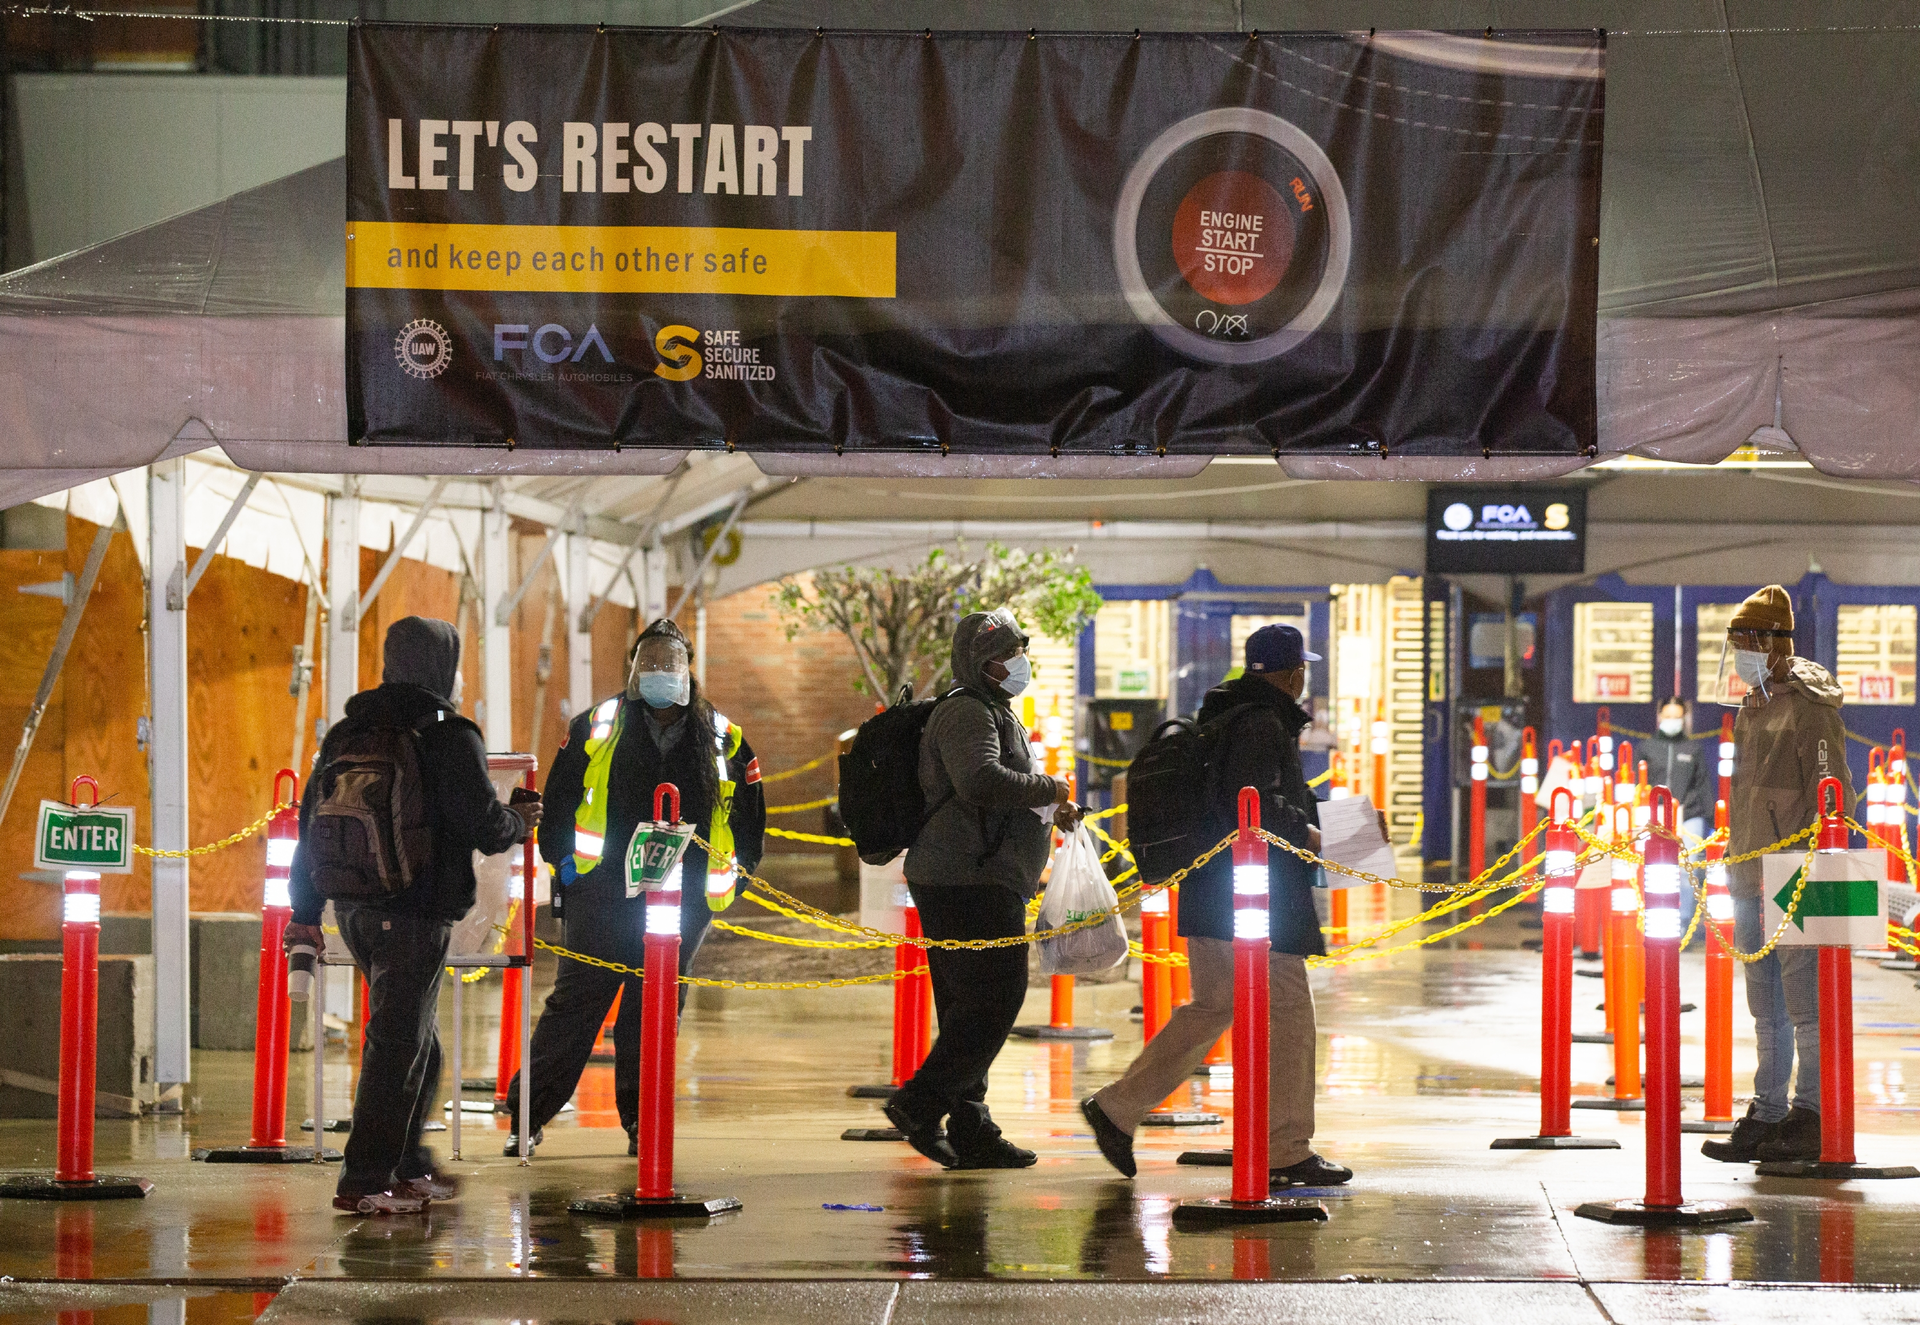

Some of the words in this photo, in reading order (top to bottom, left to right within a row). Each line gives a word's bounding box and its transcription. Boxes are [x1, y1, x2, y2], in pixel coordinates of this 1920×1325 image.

[388, 118, 539, 193] LET'S
[562, 121, 813, 197] RESTART
[1289, 176, 1314, 212] RUN
[1200, 210, 1264, 232] ENGINE
[1201, 228, 1260, 252] START
[387, 243, 438, 269] and
[449, 243, 522, 277] keep
[532, 245, 604, 272] each
[615, 245, 695, 273] other
[703, 247, 768, 275] safe
[1204, 253, 1254, 276] STOP
[411, 342, 436, 356] UAW
[493, 322, 616, 364] FCA
[704, 329, 741, 347] SAFE
[704, 347, 761, 364] SECURE
[475, 371, 498, 381] FIAT
[499, 371, 555, 382] CHRYSLER
[558, 372, 634, 382] AUTOMOBILES
[705, 363, 776, 381] SANITIZED
[1481, 504, 1532, 524] FCA
[50, 825, 119, 852] ENTER
